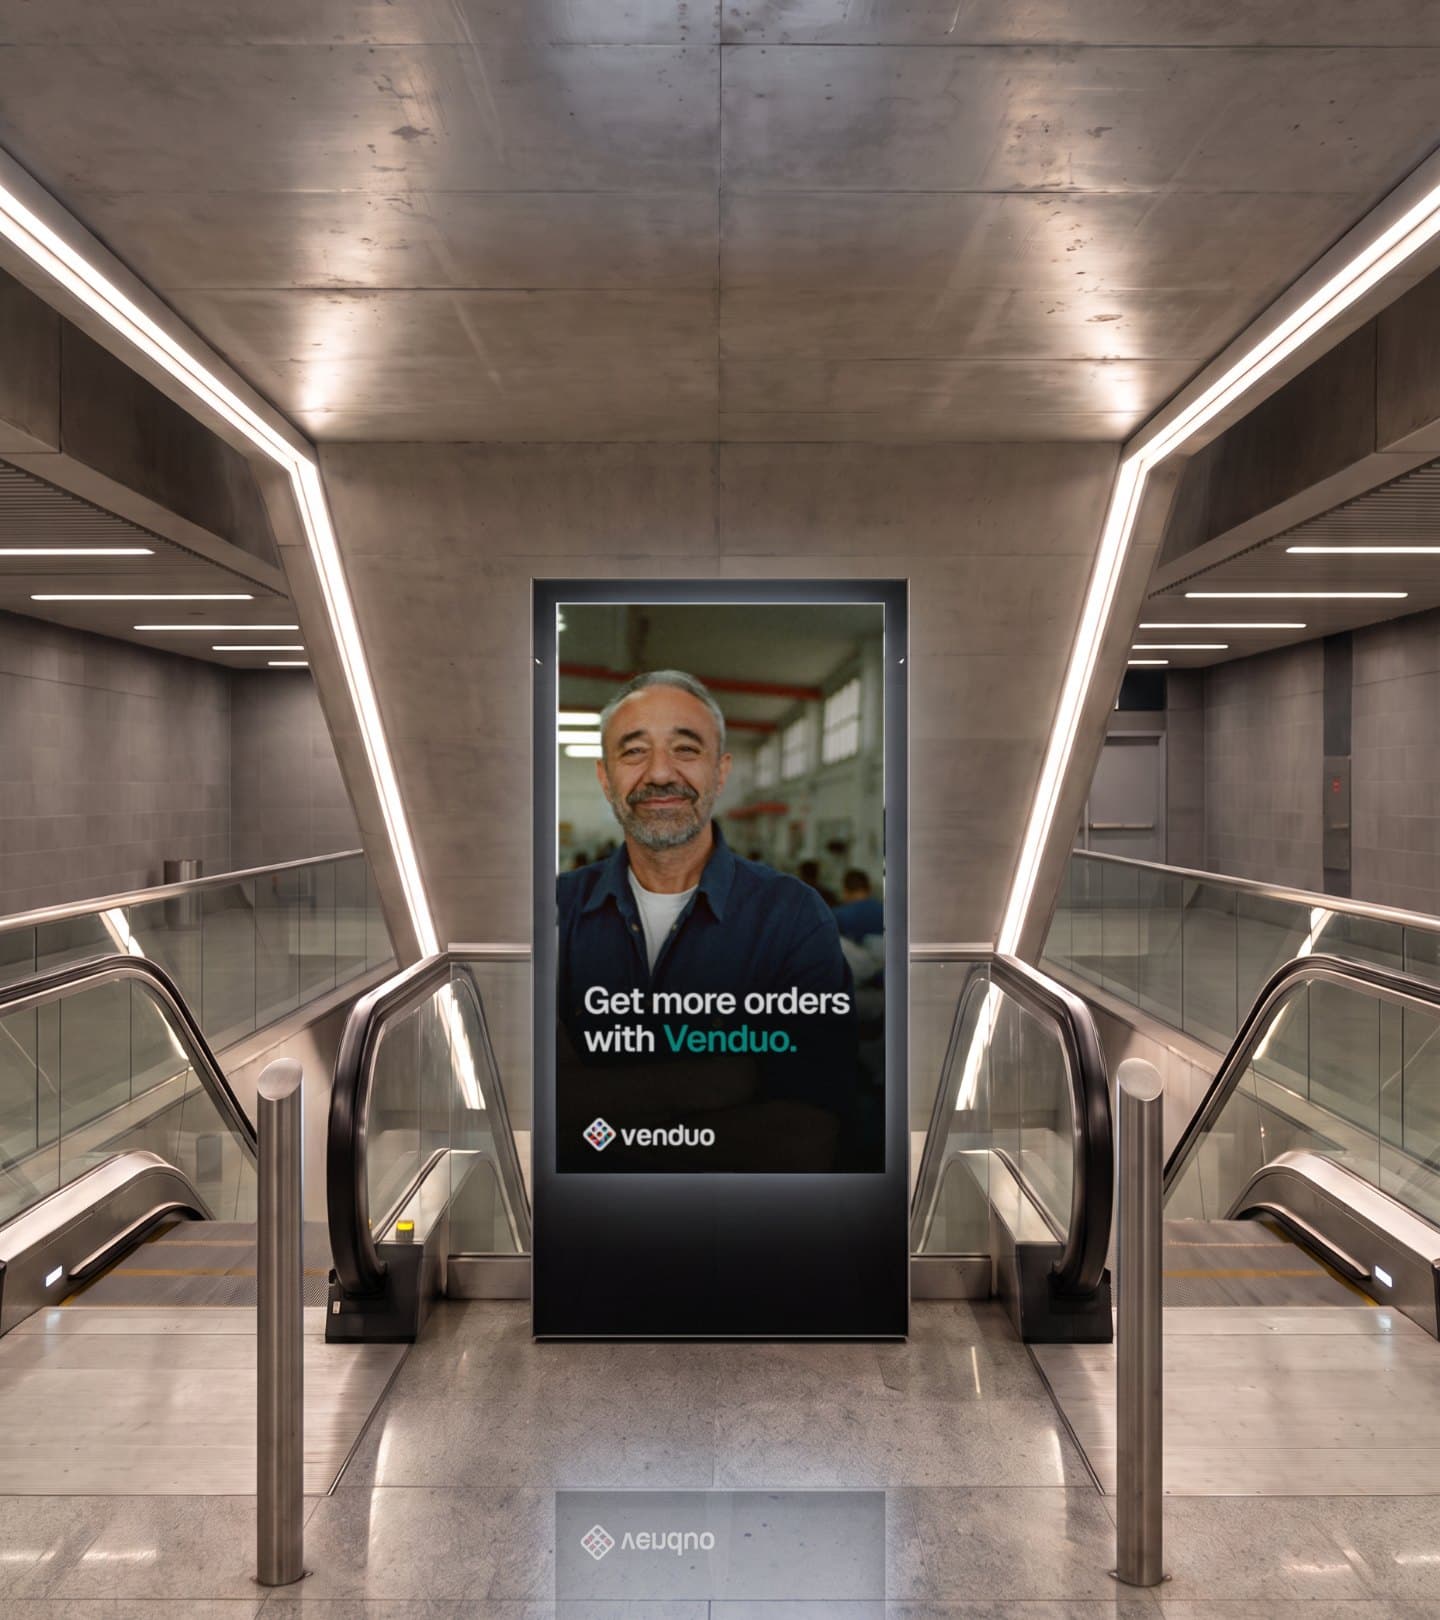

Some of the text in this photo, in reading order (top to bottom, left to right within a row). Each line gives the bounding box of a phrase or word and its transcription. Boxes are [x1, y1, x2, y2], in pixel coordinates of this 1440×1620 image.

[584, 985, 850, 1015] Get more orders
[583, 1024, 797, 1053] with Venduo.
[620, 1124, 716, 1147] venduo
